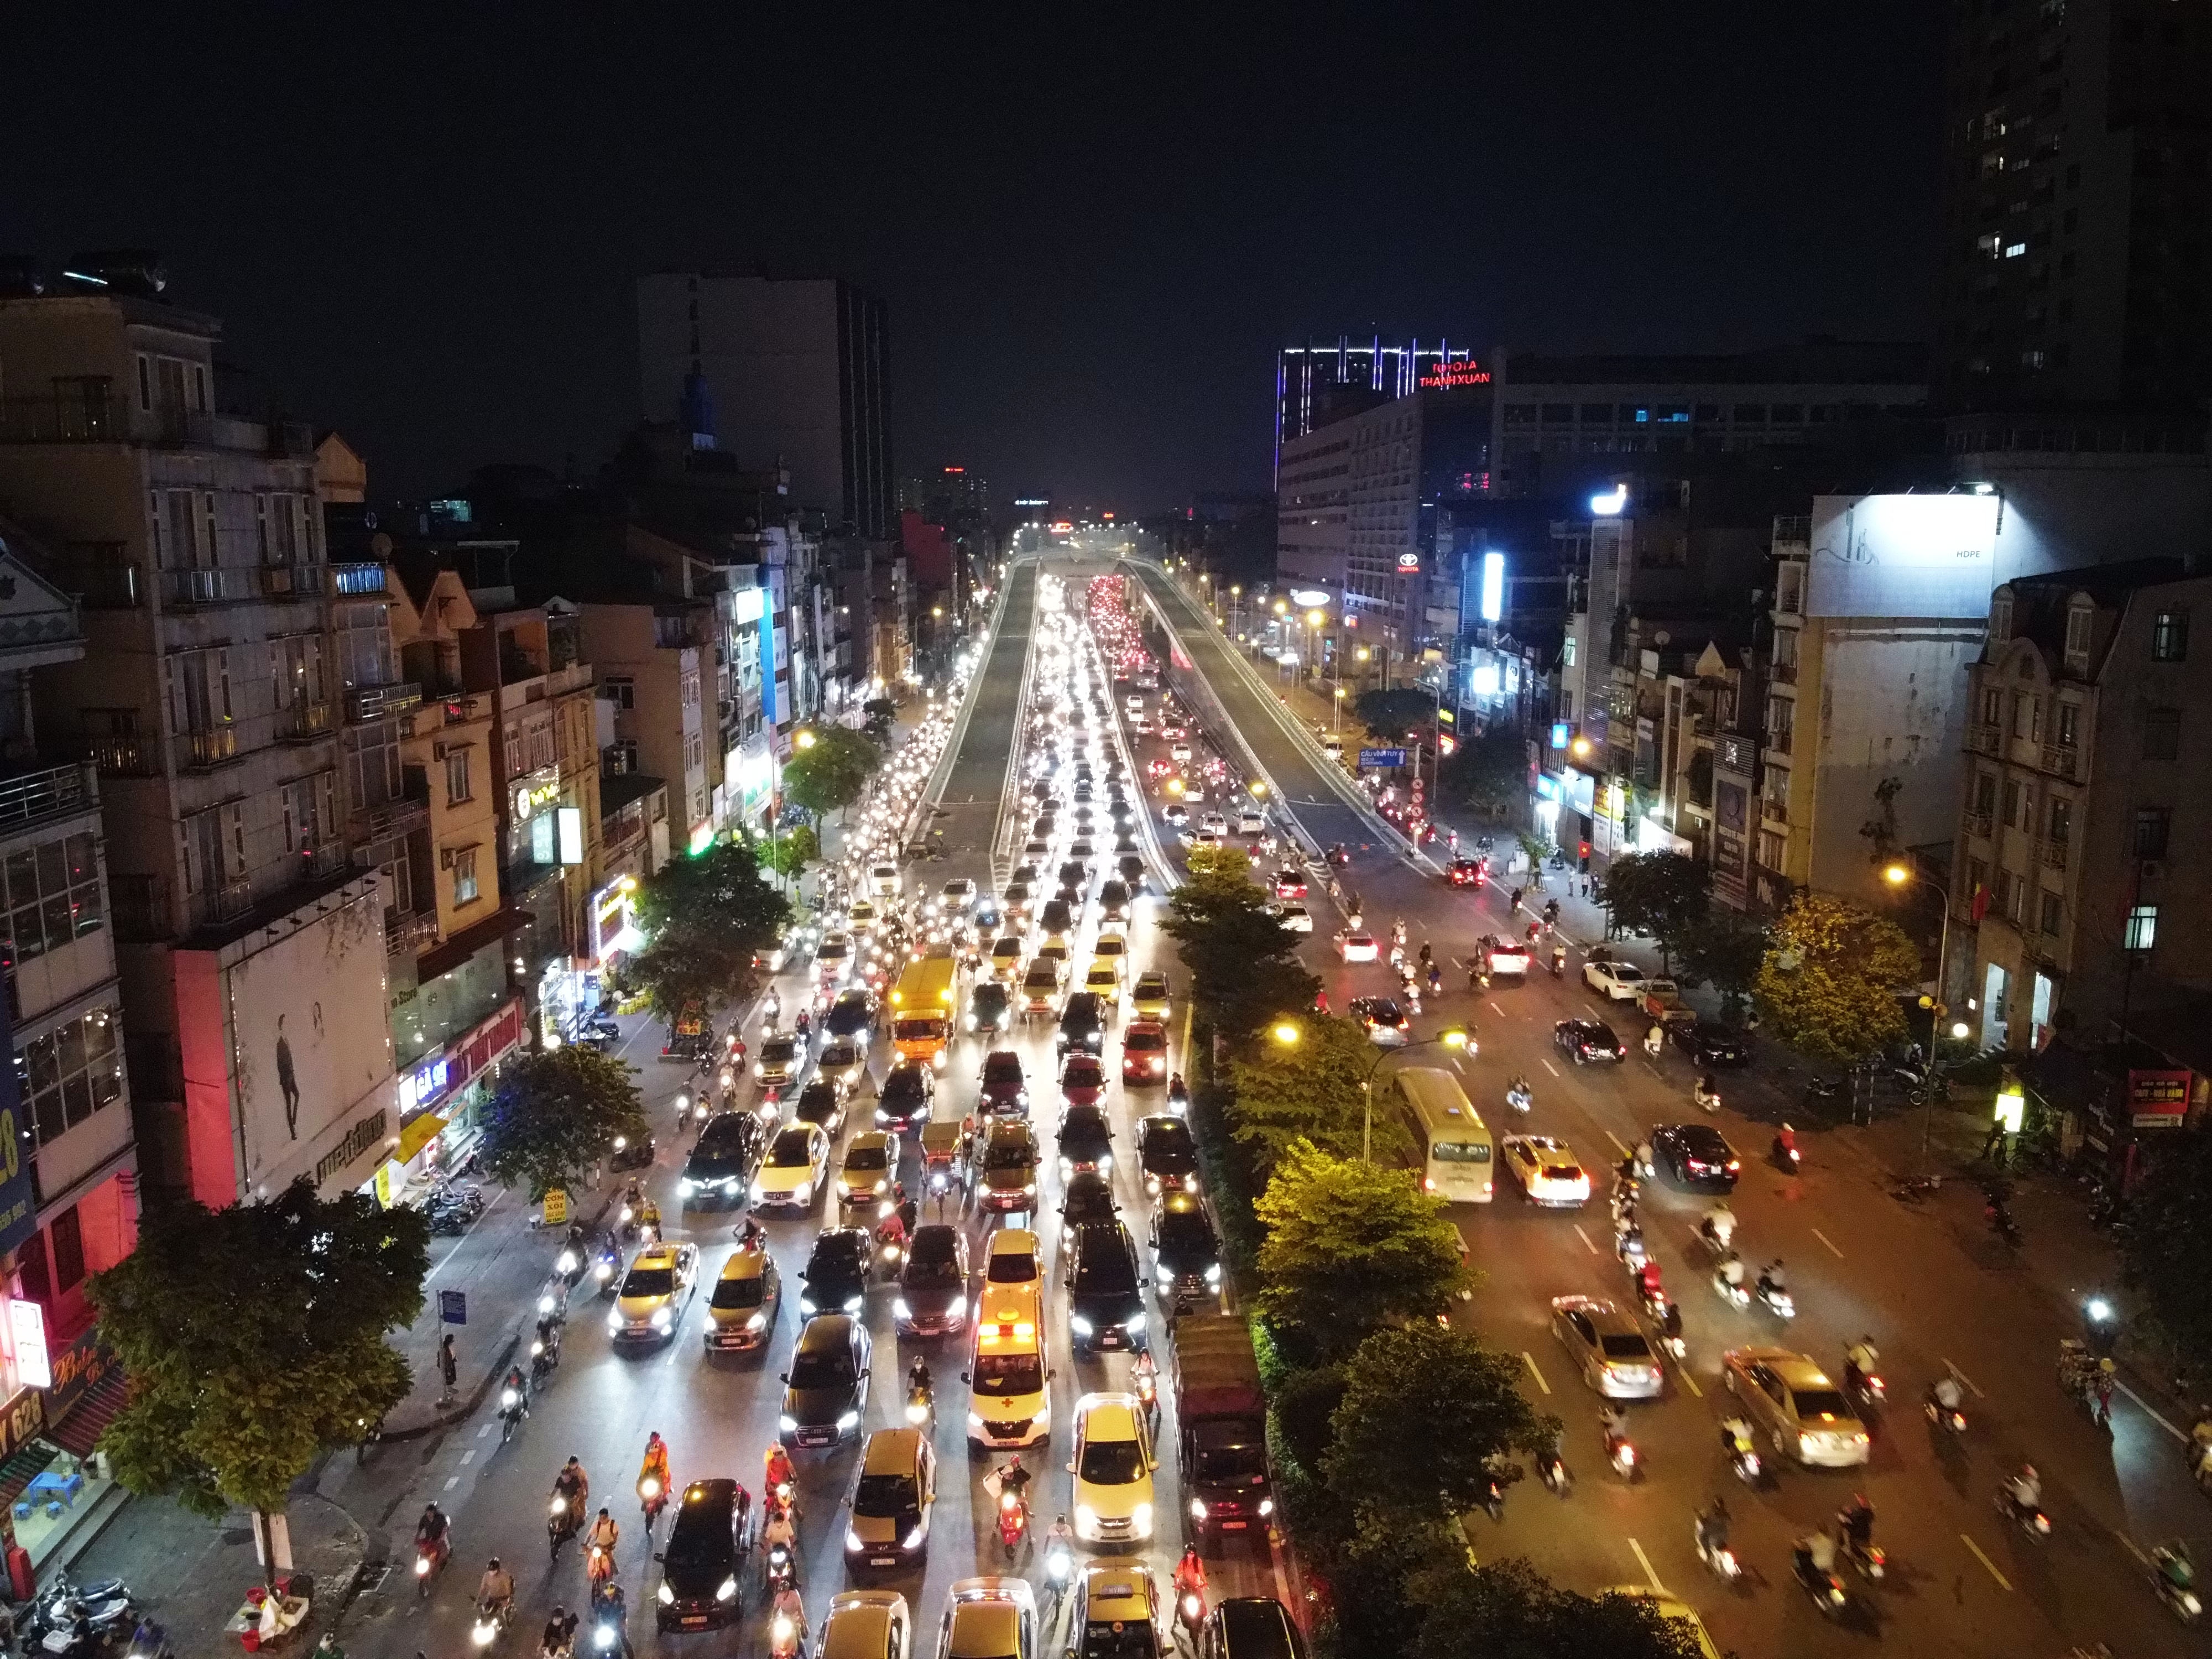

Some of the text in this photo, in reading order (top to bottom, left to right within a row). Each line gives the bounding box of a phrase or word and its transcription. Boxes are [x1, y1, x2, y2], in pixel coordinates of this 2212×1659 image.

[1432, 361, 1477, 373] TOYOTA
[1420, 373, 1490, 387] THANH XUAN
[399, 988, 417, 1005] Store
[12, 1391, 41, 1442] 628
